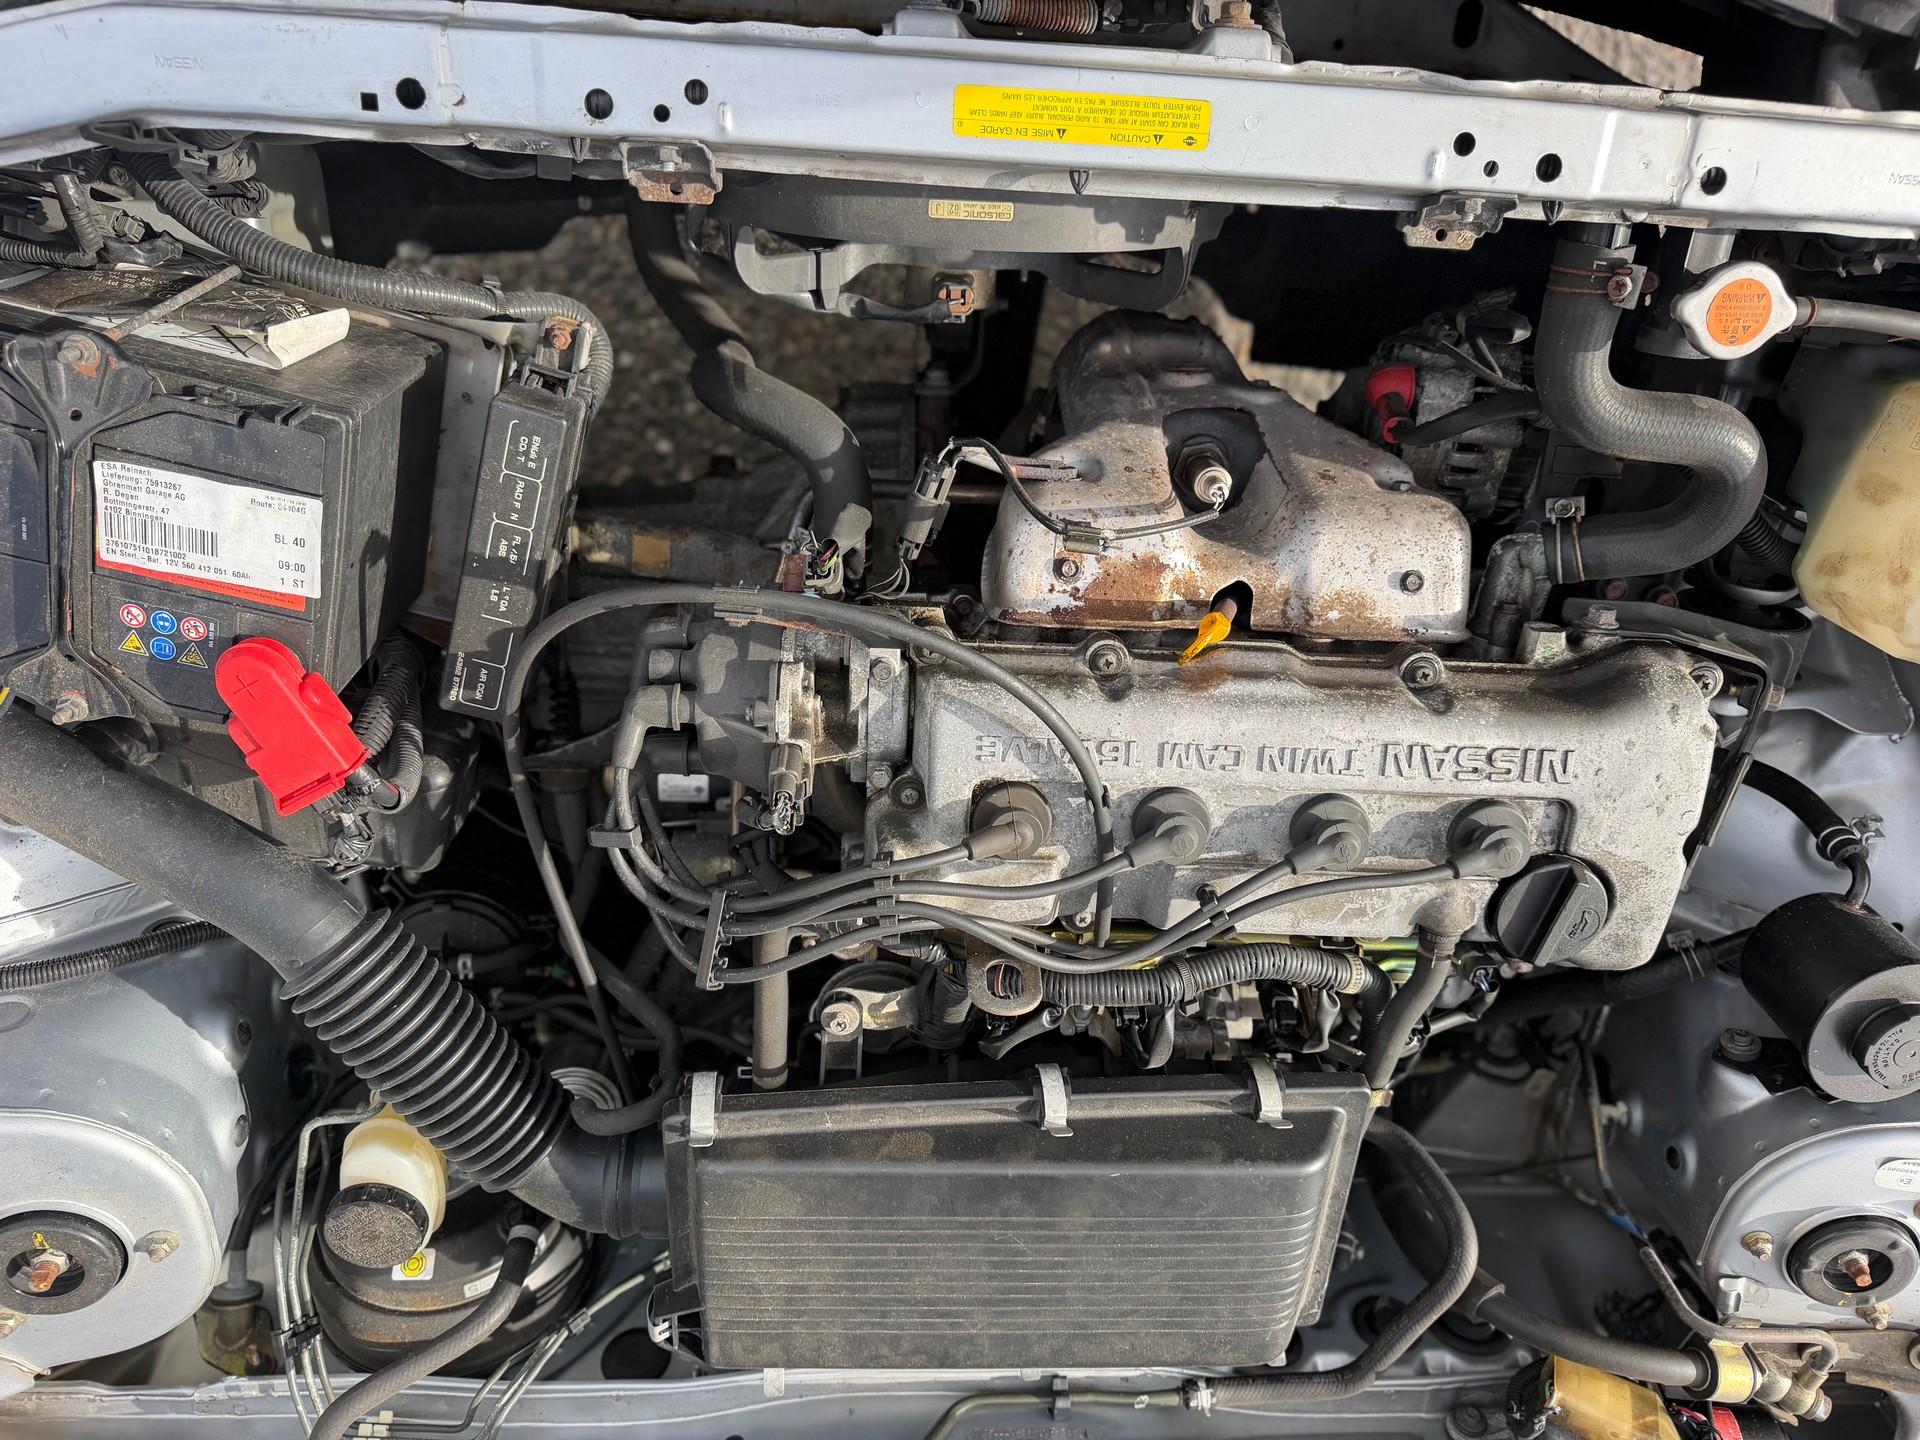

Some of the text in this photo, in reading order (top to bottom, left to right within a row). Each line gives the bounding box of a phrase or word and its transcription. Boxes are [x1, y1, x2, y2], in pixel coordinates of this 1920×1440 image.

[1084, 108, 1116, 116] DÉMARRER
[1164, 103, 1183, 112] ÉVITER
[1152, 111, 1190, 119] VENTILATEUR
[980, 125, 1054, 138] MISE EN GARDE
[1110, 133, 1151, 143] CAUTION
[1722, 293, 1754, 303] WARNING
[517, 436, 528, 462] COT
[528, 435, 541, 469] ENGIE
[121, 464, 152, 476] Reinach
[102, 471, 181, 491] Lieferung: 75913267
[114, 490, 139, 500] Degen
[146, 487, 172, 499] Garage
[104, 496, 158, 513] Bottmingerstr.
[251, 498, 275, 509] Route:
[510, 480, 525, 521] RAD FN
[104, 505, 163, 521] 4102 Binningen
[274, 534, 305, 548] BL 40
[166, 559, 179, 567] 12V
[198, 565, 211, 573] 412
[213, 567, 227, 576] 051
[278, 560, 305, 573] 09:00
[293, 578, 305, 588] ST
[474, 668, 488, 700] AIR CON
[1100, 739, 1143, 768] 16
[1156, 740, 1248, 772] CAM
[1256, 744, 1364, 777] TWIN
[1380, 742, 1575, 784] NISSAN
